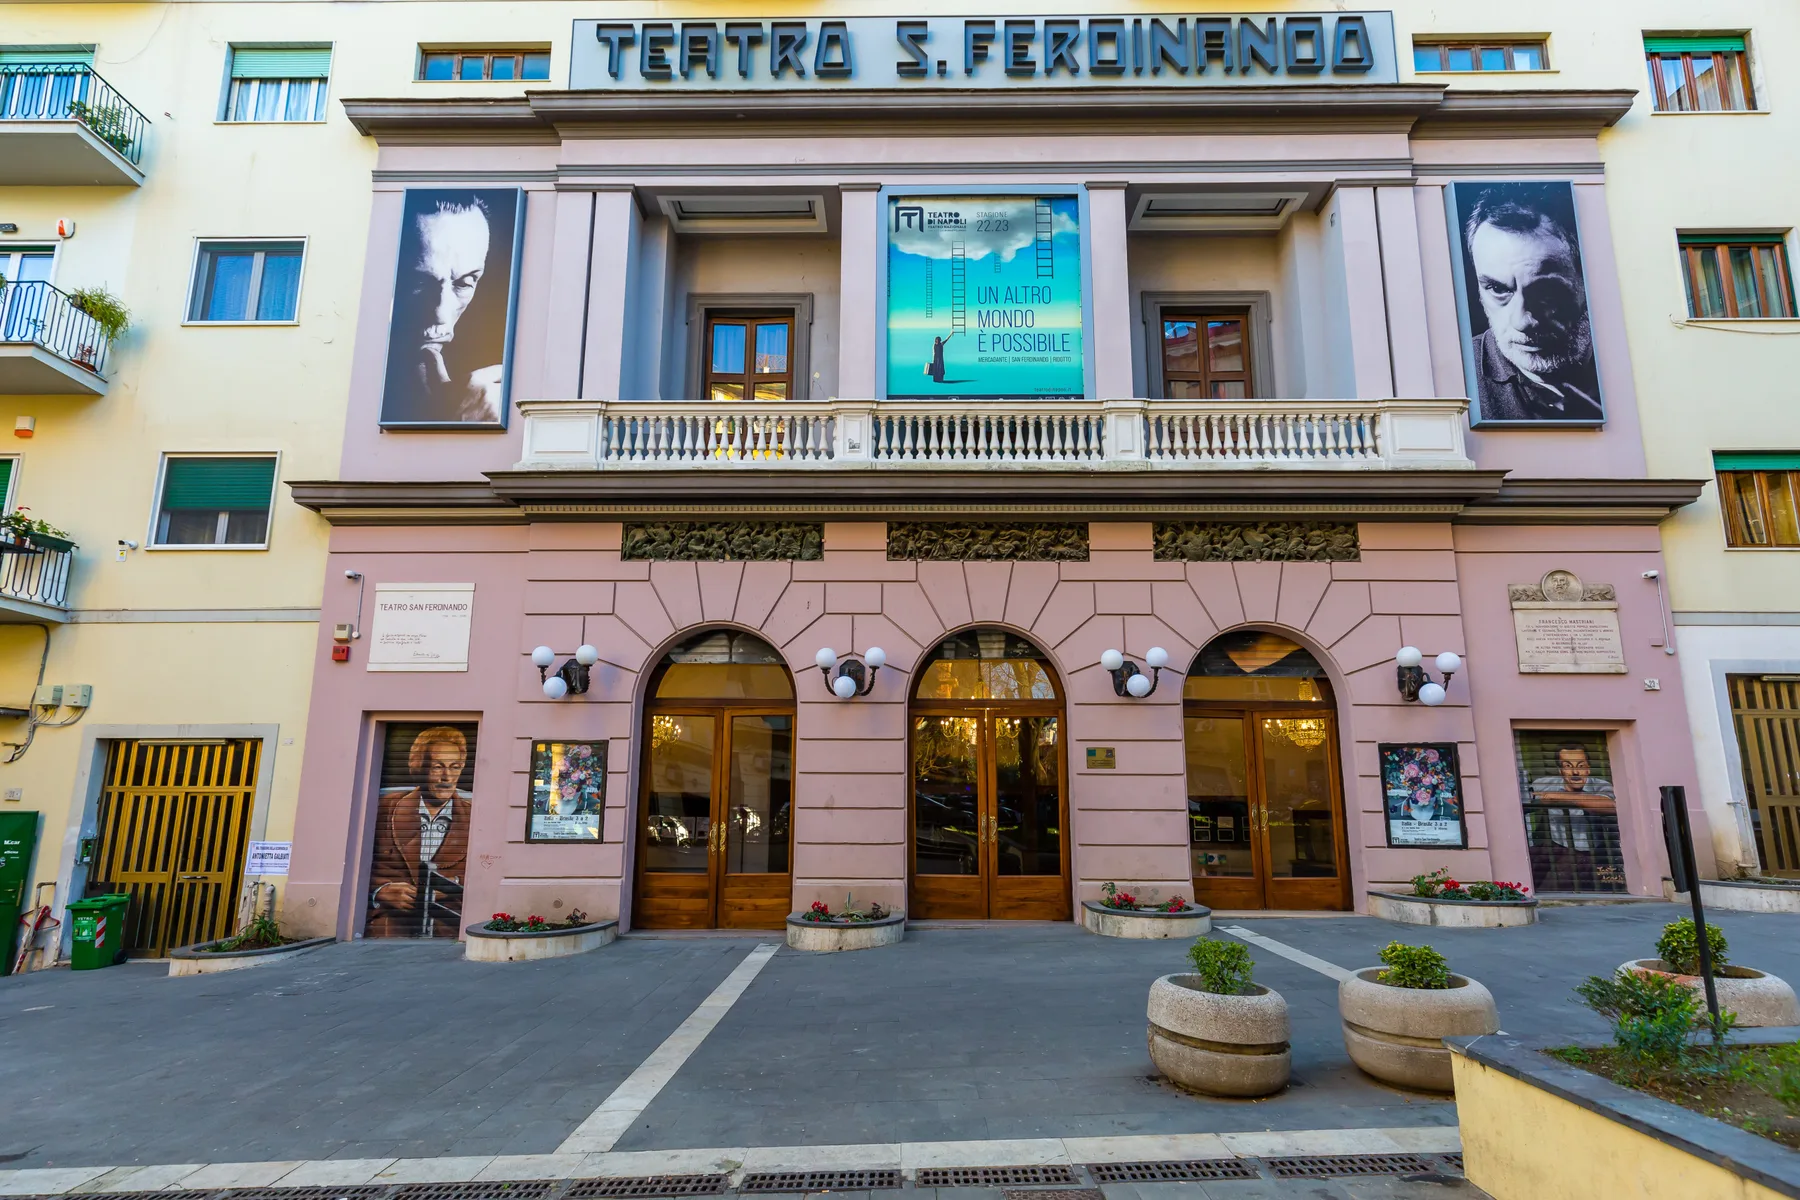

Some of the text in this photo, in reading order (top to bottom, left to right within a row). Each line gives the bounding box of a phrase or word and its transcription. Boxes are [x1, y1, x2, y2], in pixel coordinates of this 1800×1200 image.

[596, 15, 1375, 79] TEATRO S. FERDINANDO
[976, 220, 1009, 232] 22.23
[977, 286, 1051, 304] UN ALTRO
[977, 310, 1035, 328] MONDO
[978, 330, 1071, 352] È POSSIBILE
